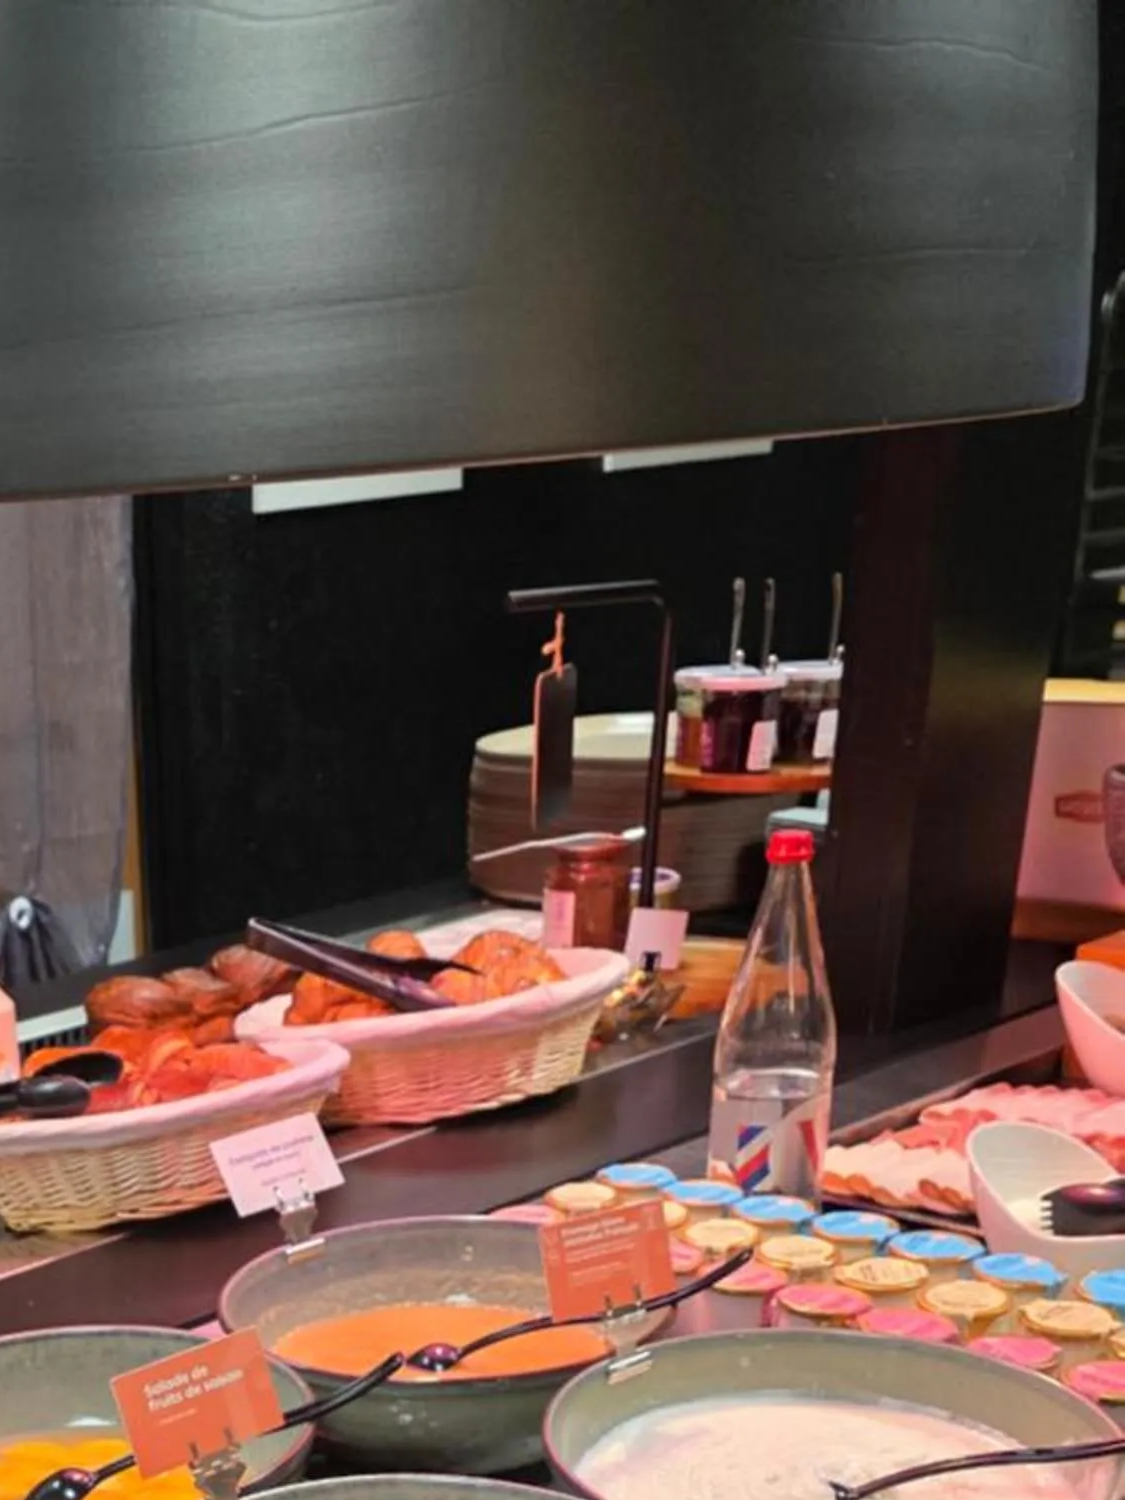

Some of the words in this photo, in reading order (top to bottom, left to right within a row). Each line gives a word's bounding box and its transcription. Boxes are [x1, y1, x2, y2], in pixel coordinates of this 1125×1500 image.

[190, 1364, 209, 1380] de
[147, 1391, 184, 1412] fruits
[184, 1384, 202, 1399] de
